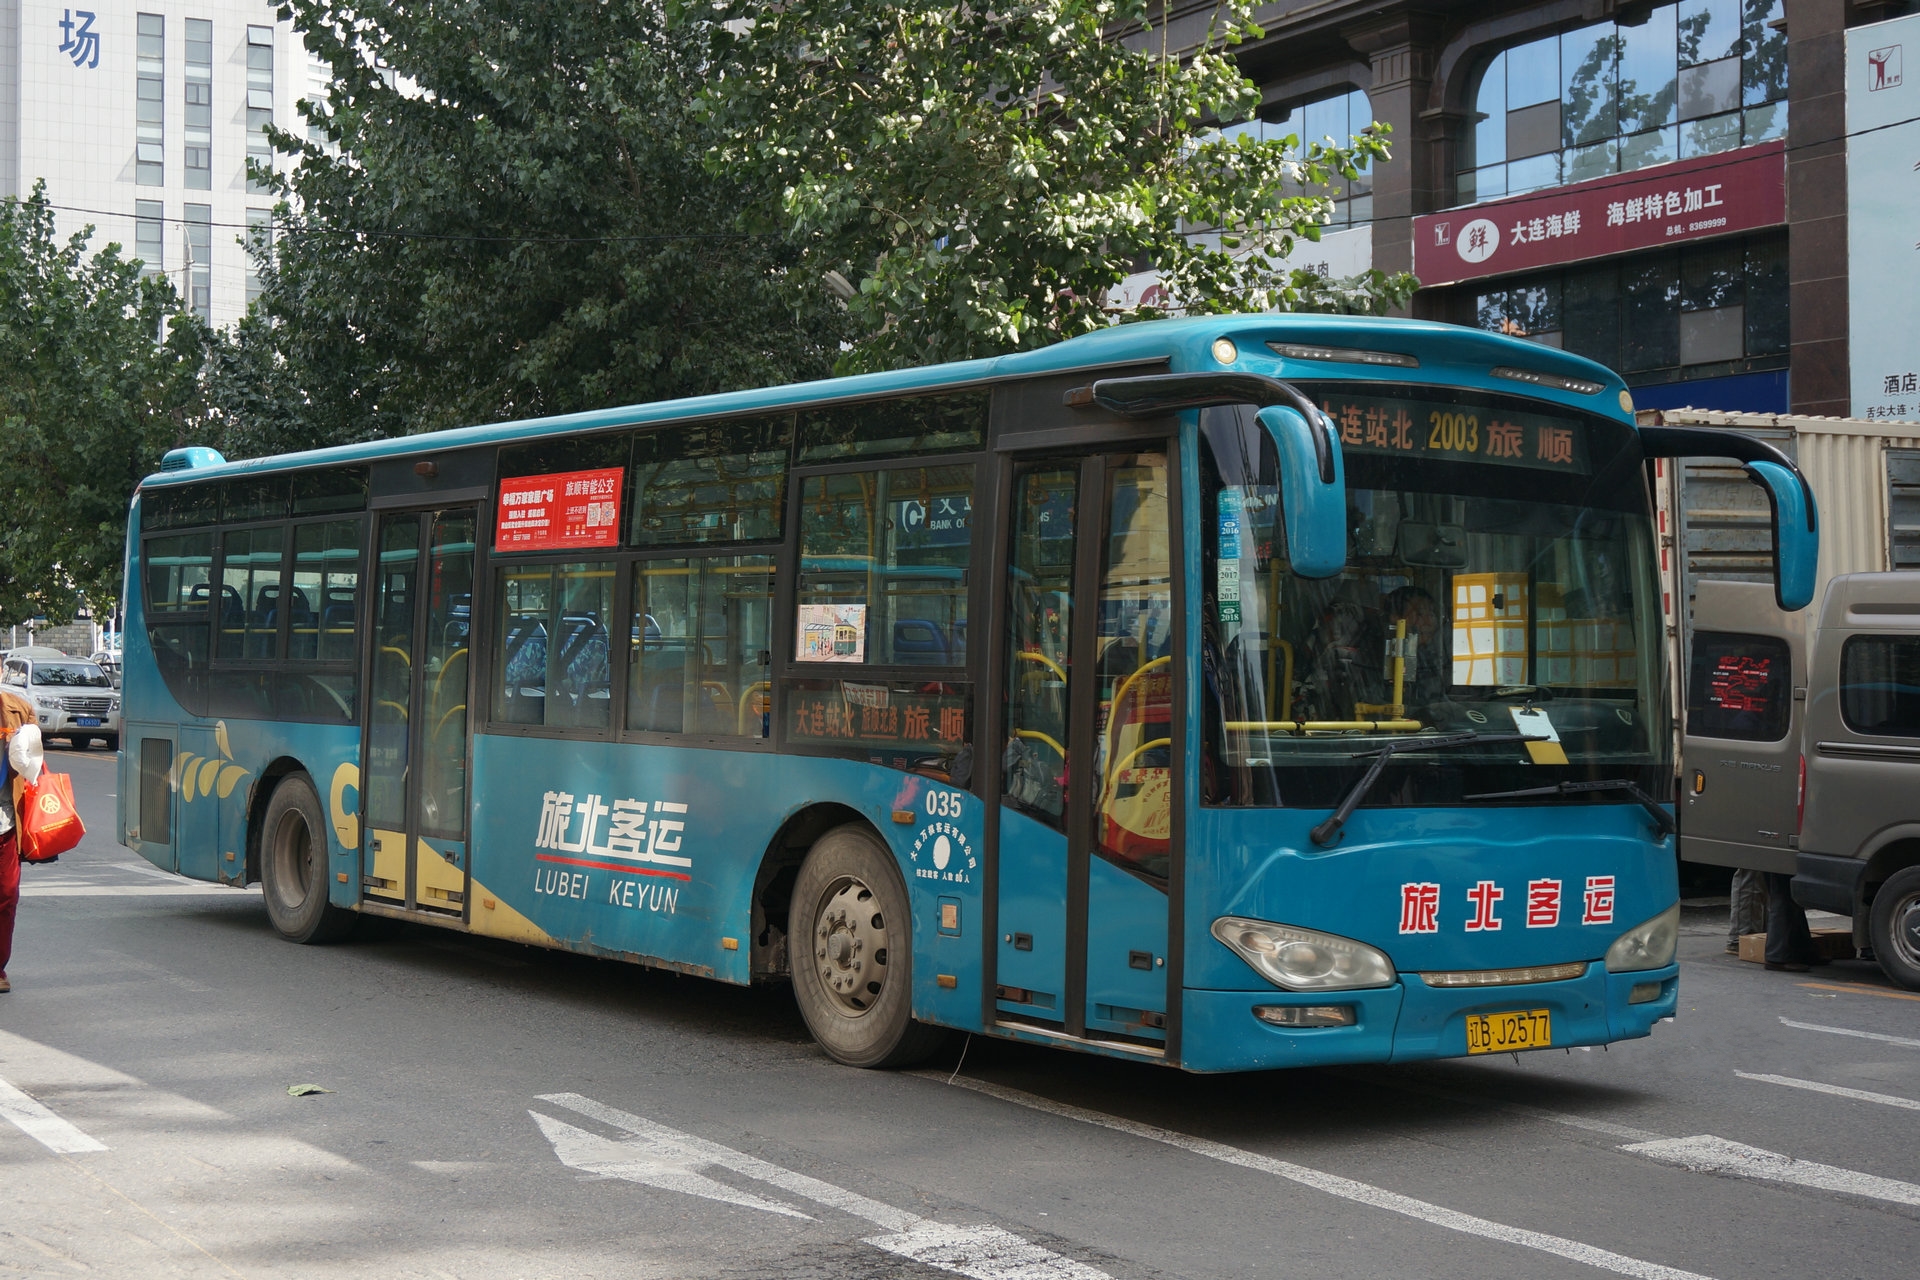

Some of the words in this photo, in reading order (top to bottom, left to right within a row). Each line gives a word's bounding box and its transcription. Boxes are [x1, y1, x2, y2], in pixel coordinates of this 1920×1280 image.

[58, 8, 100, 69] 场
[1510, 209, 1582, 247] 大连海鲜
[1606, 183, 1724, 227] 海鲜特色加工
[1689, 217, 1727, 232] 83699999
[1468, 224, 1489, 257] 鲜
[1884, 372, 1920, 394] 酒店
[1866, 403, 1920, 419] 舌尖大连·
[1429, 410, 1479, 452] 2003
[930, 519, 953, 530] BANK
[1221, 526, 1240, 535] 2016
[1219, 571, 1238, 579] 2017
[1219, 592, 1238, 600] 2017
[1220, 613, 1240, 621] 2018
[795, 700, 855, 738] 大连站北
[926, 790, 962, 818] 035
[535, 791, 692, 868] 旅北客运
[534, 868, 590, 900] LUBEI
[609, 879, 679, 914] KEYUN
[1399, 875, 1615, 934] 旅北客运
